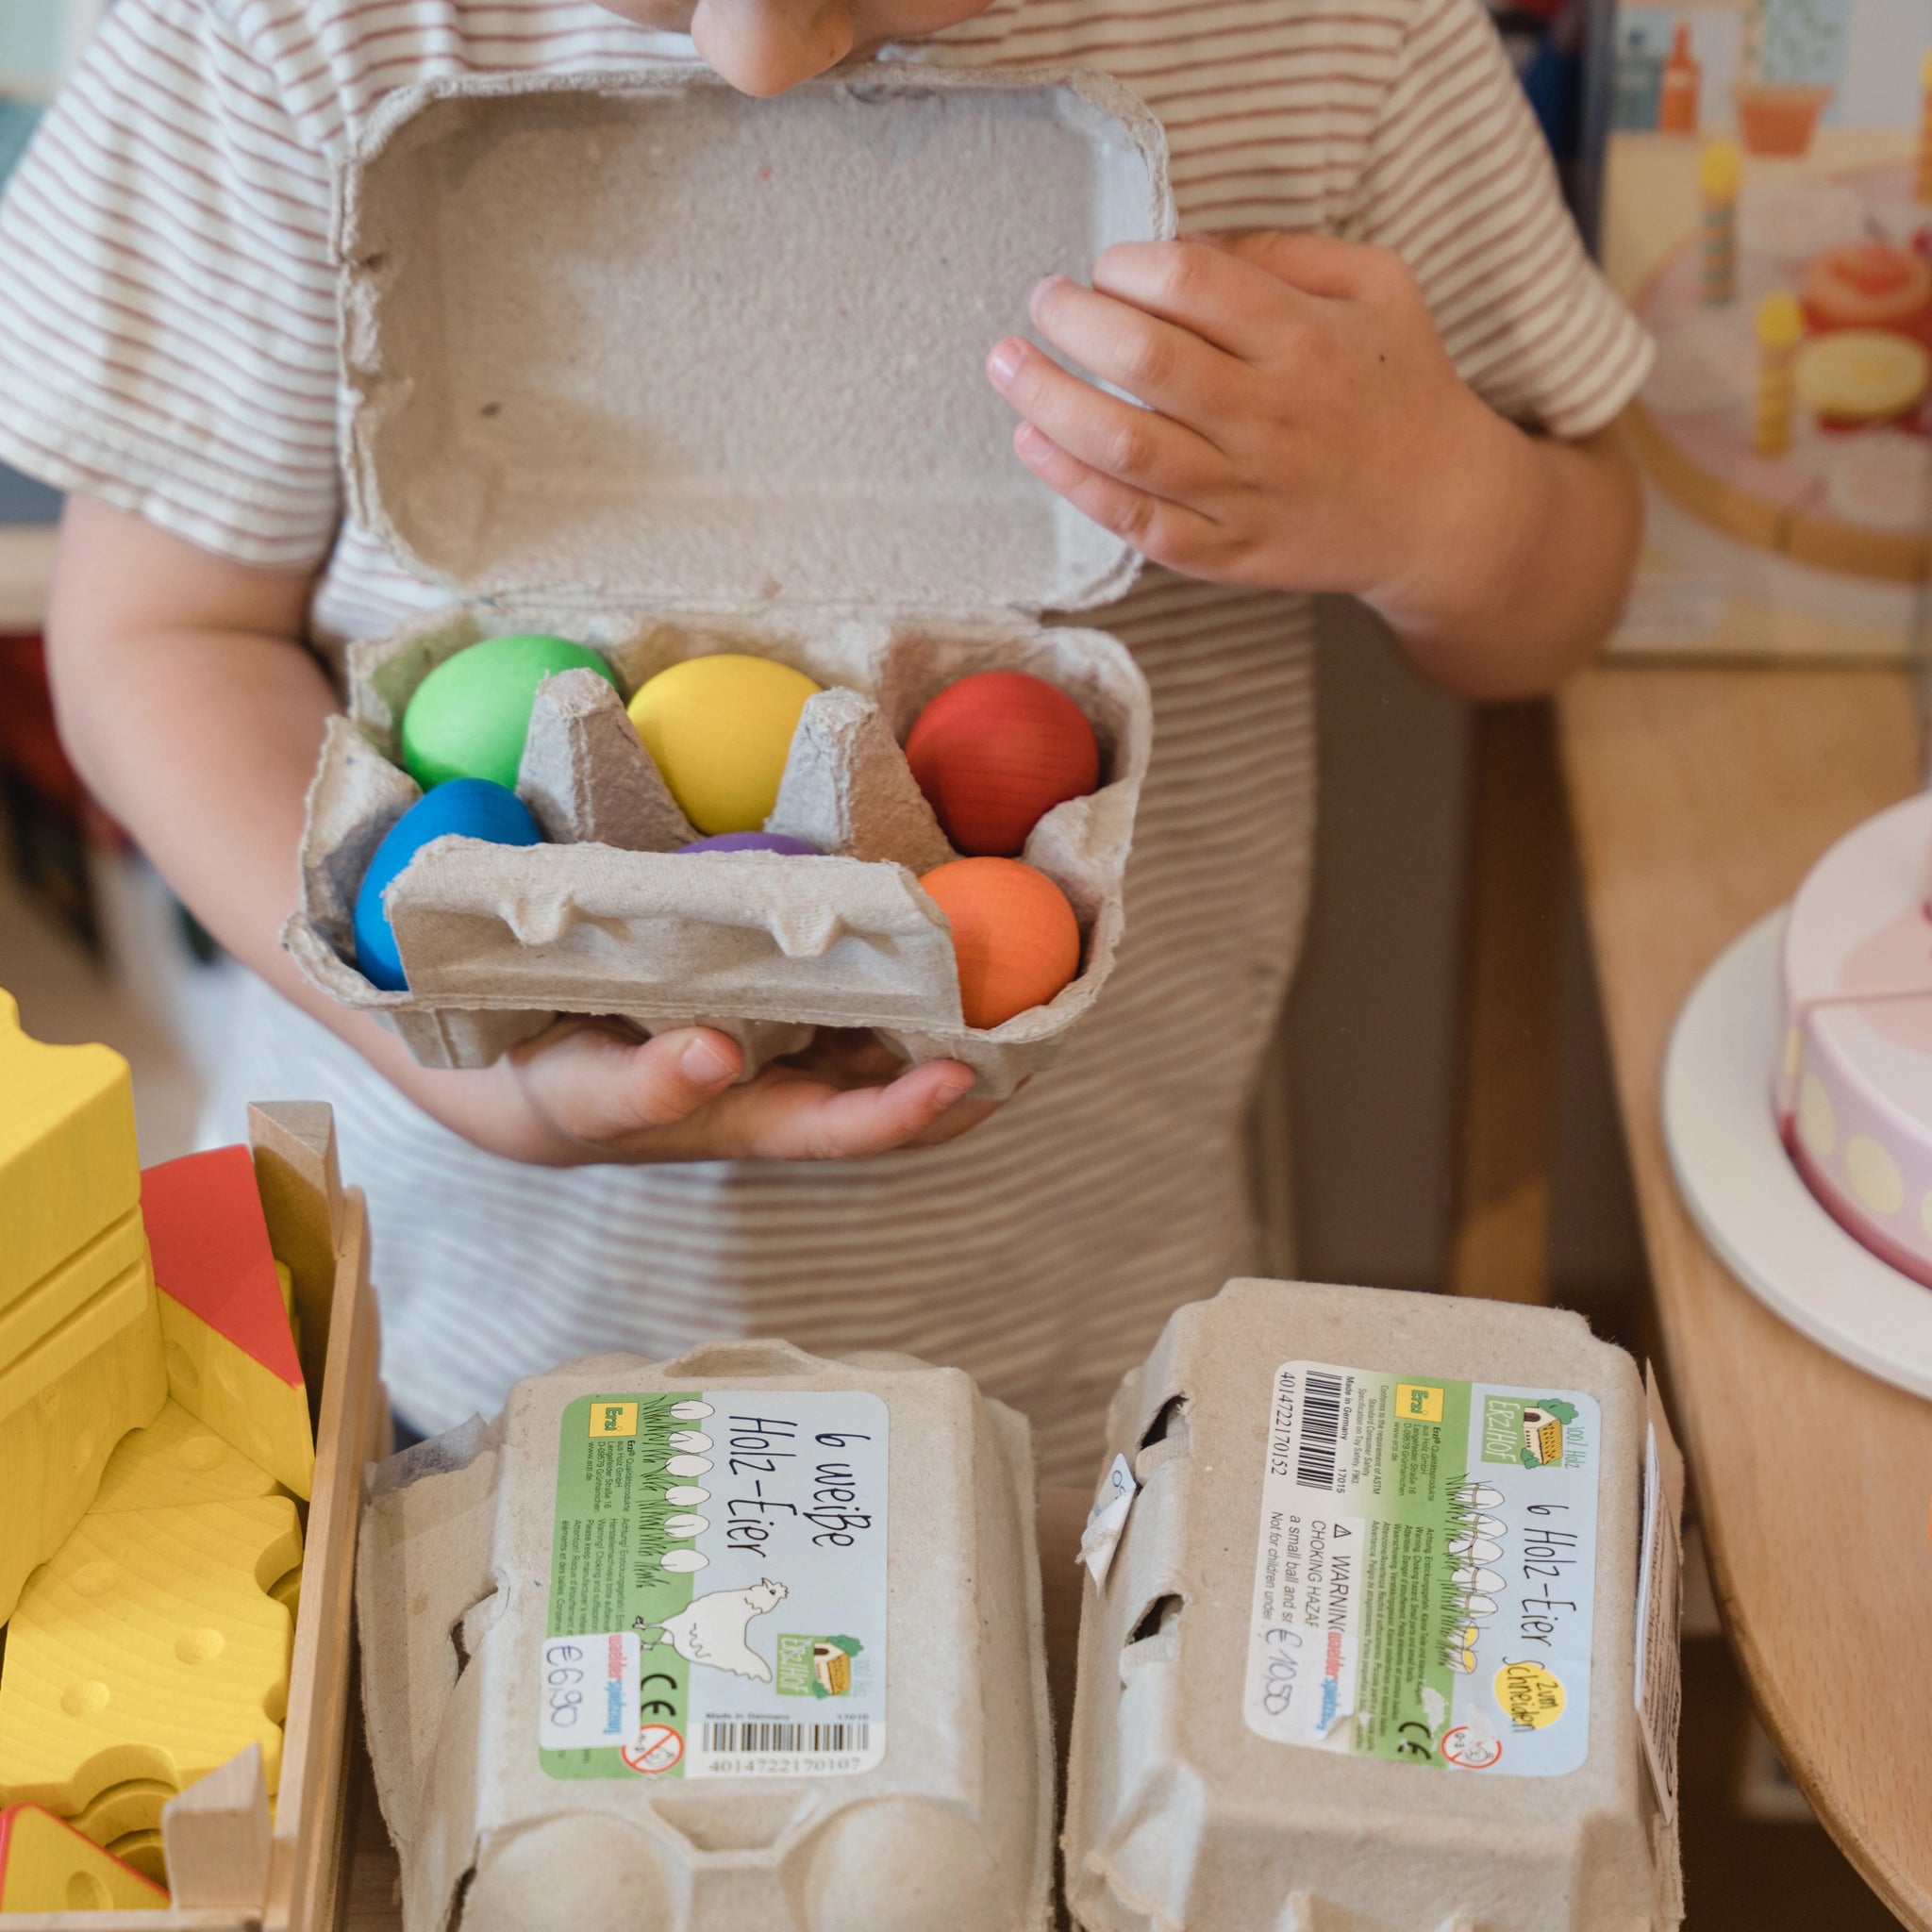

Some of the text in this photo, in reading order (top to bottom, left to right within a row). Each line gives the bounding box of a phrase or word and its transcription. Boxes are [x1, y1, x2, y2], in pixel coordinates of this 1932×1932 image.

[1345, 1376, 1355, 1395] Made
[1378, 1385, 1389, 1411] Conforms
[1356, 1388, 1367, 1425] Specification
[1410, 1390, 1429, 1415] Erzi
[605, 1407, 624, 1431] Erzi
[1271, 1372, 1296, 1475] 4014722170152
[1340, 1407, 1352, 1441] Germany
[1377, 1420, 1386, 1429] the
[1353, 1435, 1363, 1446] Toy
[1361, 1398, 1377, 1476] Standard Consumer Safety
[1374, 1430, 1384, 1467] requirement
[1391, 1421, 1400, 1461] www.erzi.de
[1410, 1424, 1421, 1461] Lengefelder
[1421, 1438, 1430, 1451] Holz
[1564, 1426, 1589, 1469] 100% Holz
[1398, 1423, 1412, 1496] D-09579 Grünhainichen
[1408, 1463, 1419, 1485] Straße
[1420, 1453, 1429, 1474] GmbH
[1427, 1445, 1441, 1502] Qualitätsprodukte
[593, 1441, 606, 1512] D-09579 Grünhainichen
[604, 1441, 614, 1509] Lengefelder Straße 16
[615, 1468, 624, 1488] GmbH
[623, 1457, 634, 1512] Qualitätsprodukte
[726, 1416, 798, 1557] Holz-Eier
[803, 1433, 872, 1547] 6 weiße
[1337, 1468, 1347, 1493] 17015
[1373, 1474, 1382, 1494] ASTM
[585, 1519, 594, 1541] Please
[1290, 1515, 1301, 1524] a
[583, 1543, 592, 1559] keep
[1287, 1526, 1301, 1559] small
[1307, 1520, 1326, 1583] CHOKING
[558, 1561, 567, 1574] des
[592, 1551, 604, 1578] Choking
[1263, 1511, 1283, 1621] Not for children under
[1285, 1561, 1301, 1583] ball
[1401, 1555, 1410, 1578] Danger
[1411, 1555, 1422, 1579] Choking
[1521, 1504, 1578, 1647] 6 Holz-Eier
[1283, 1586, 1297, 1609] and
[641, 1674, 677, 1717] CE
[1503, 1657, 1545, 1733] Schneiden
